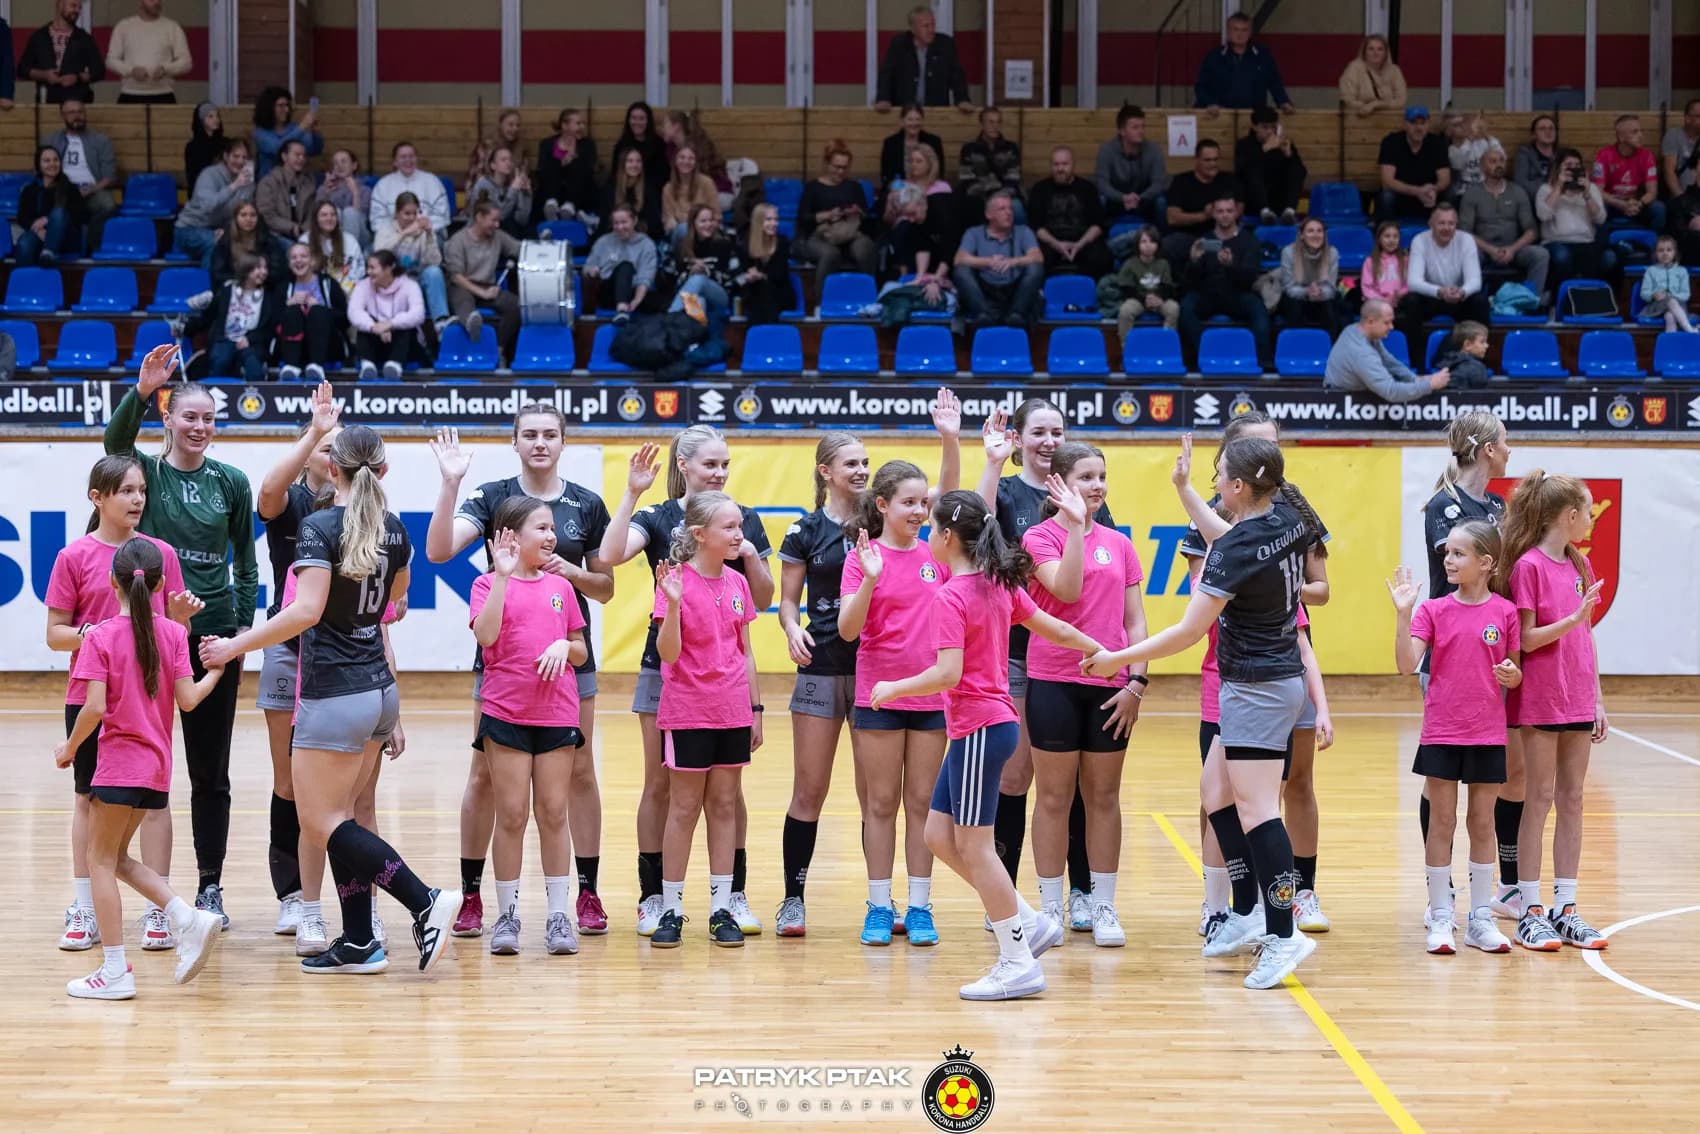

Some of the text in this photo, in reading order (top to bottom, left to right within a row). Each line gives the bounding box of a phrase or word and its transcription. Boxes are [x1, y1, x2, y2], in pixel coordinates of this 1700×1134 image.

[1176, 133, 1189, 146] A
[67, 151, 80, 166] 13
[771, 390, 1103, 425] www.koronandll.pl
[180, 480, 201, 504] 12
[357, 555, 389, 615] 13
[1279, 551, 1305, 614] 14
